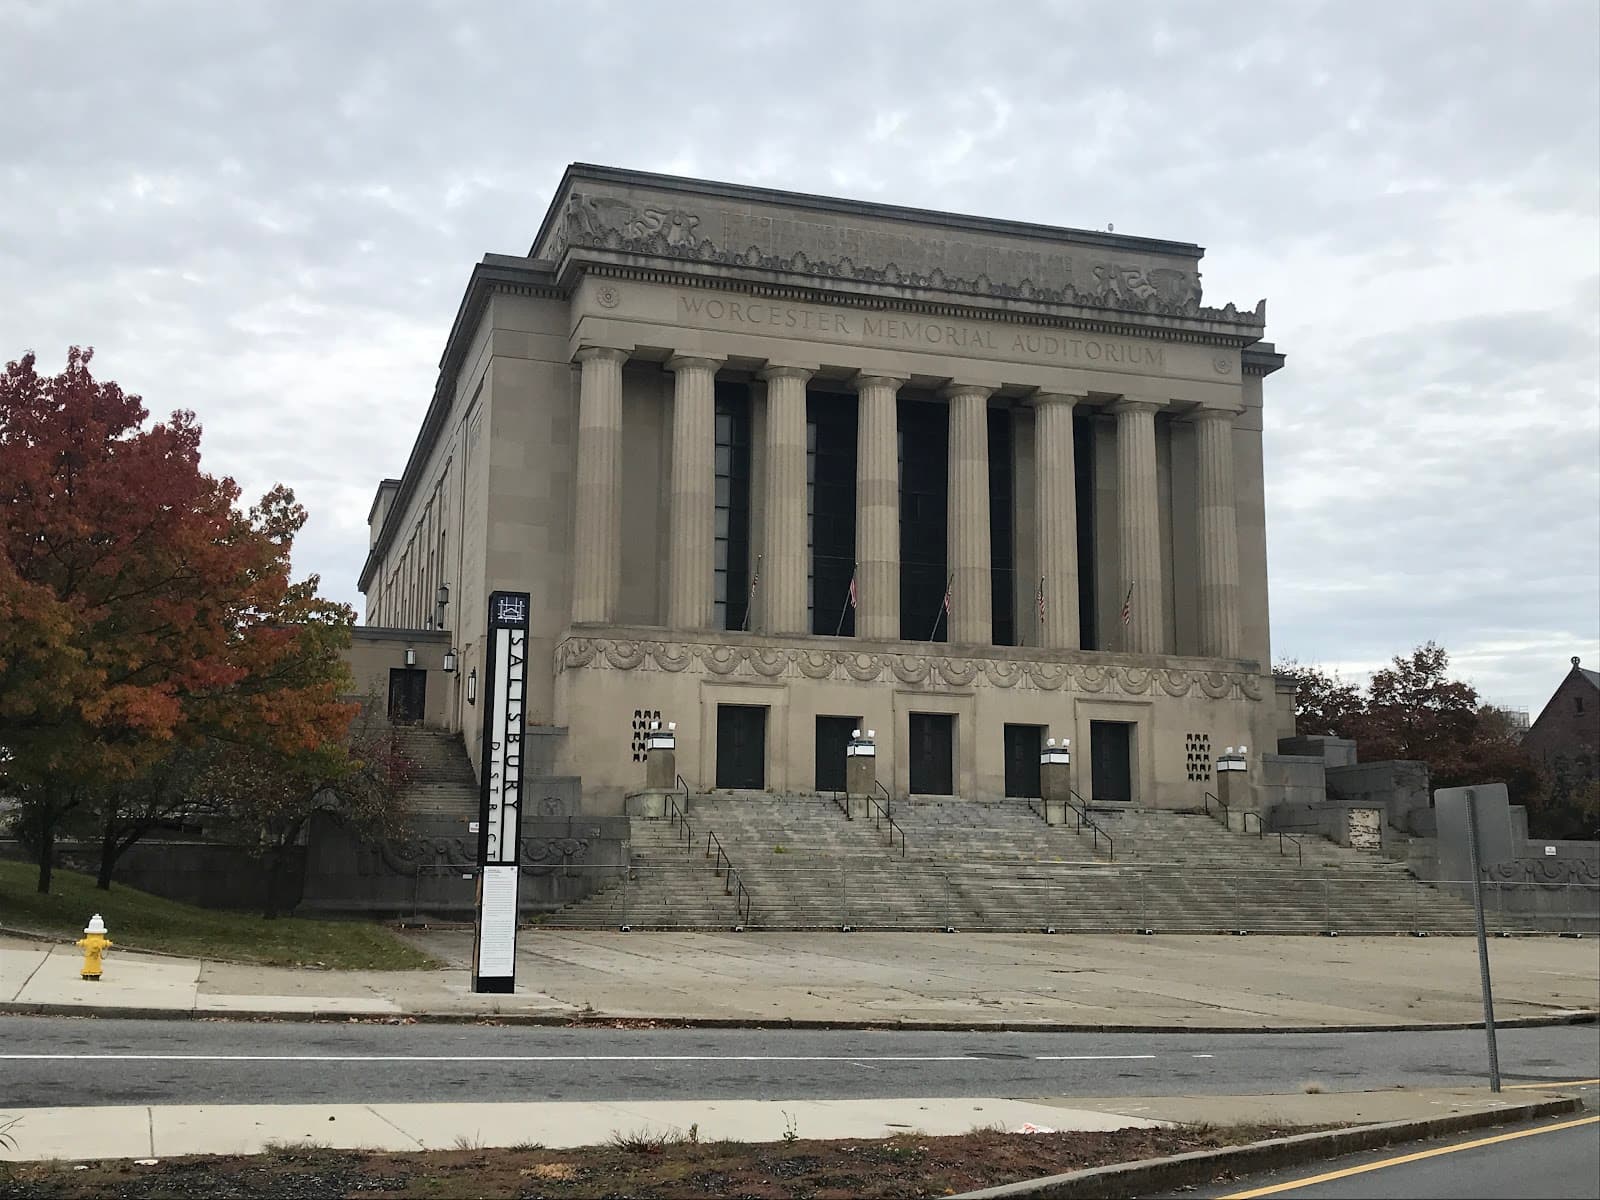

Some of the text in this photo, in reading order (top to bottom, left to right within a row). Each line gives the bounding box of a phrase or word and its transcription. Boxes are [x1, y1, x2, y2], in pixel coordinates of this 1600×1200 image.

[681, 297, 1166, 366] WORCESTER MEMORIAL AUDITORIUM
[504, 637, 524, 809] SALISBURY
[487, 742, 500, 859] DISTRICT
